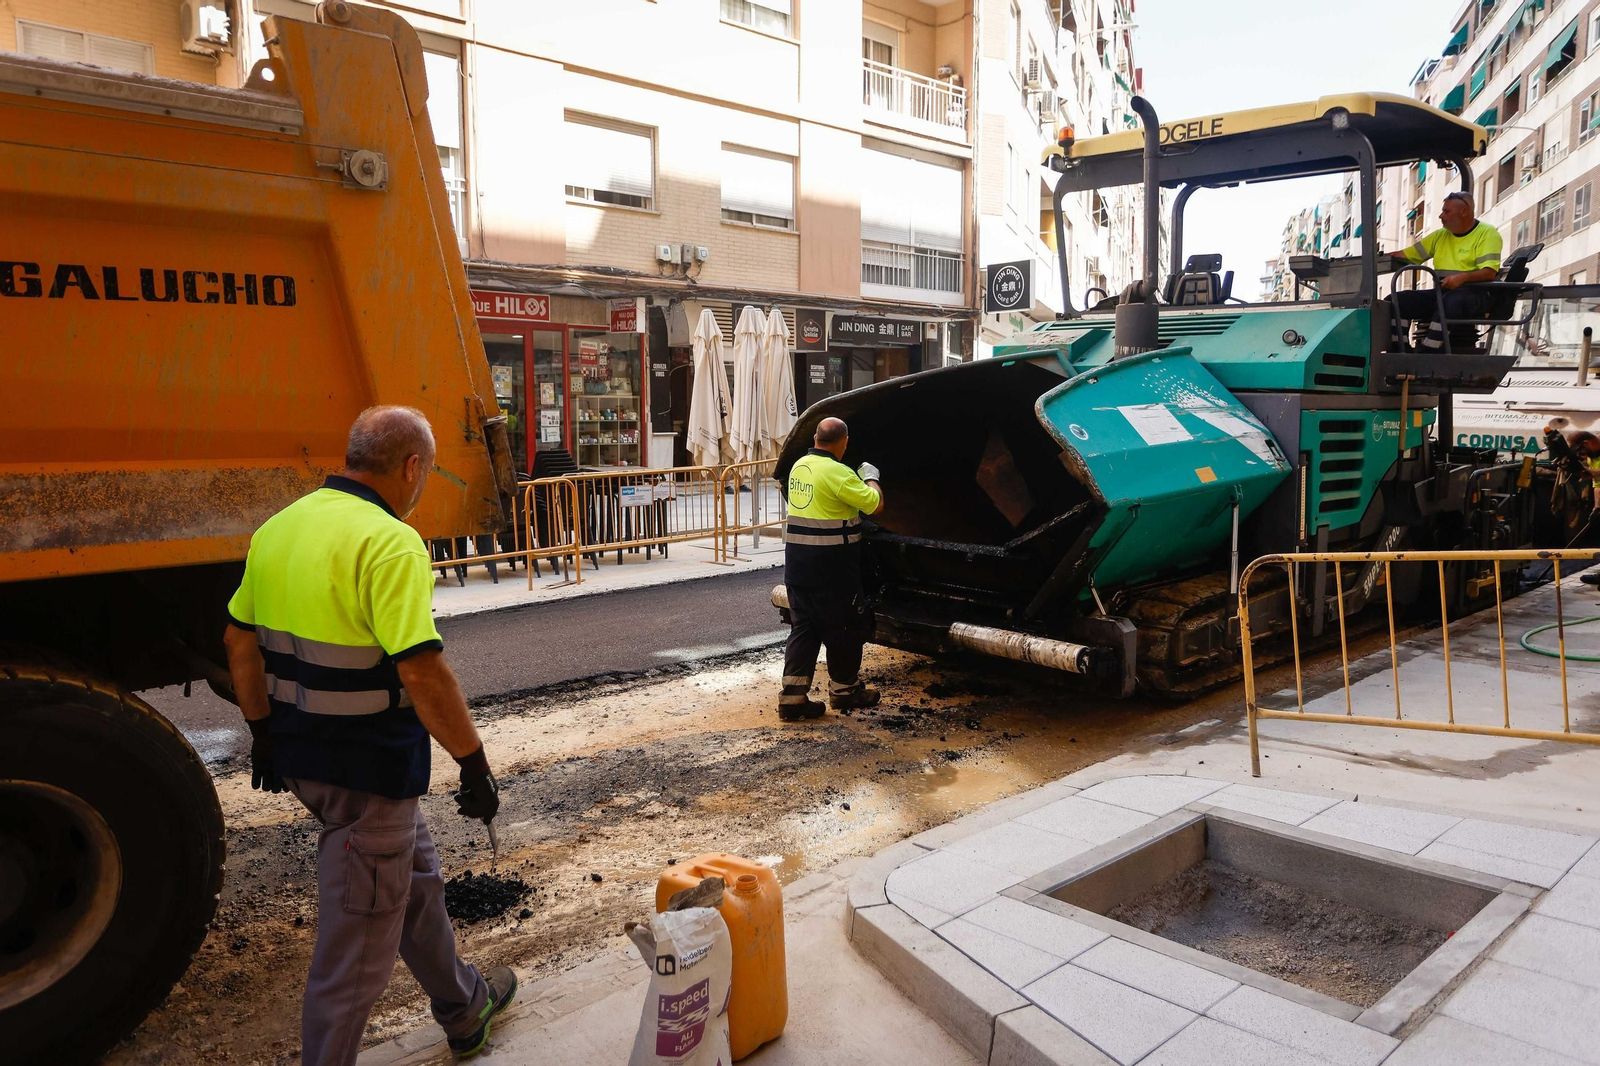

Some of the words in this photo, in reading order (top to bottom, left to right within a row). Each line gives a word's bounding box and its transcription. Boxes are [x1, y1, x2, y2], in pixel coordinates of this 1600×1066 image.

[1142, 118, 1223, 144] ÖGELE
[997, 271, 1006, 283] JIN
[1006, 269, 1020, 280] DING
[0, 261, 297, 307] GALUCHO
[1001, 281, 1016, 292] 金鼎
[1010, 291, 1019, 302] BAR
[472, 301, 490, 313] UE
[495, 296, 547, 316] HILOS
[839, 322, 852, 332] JIN
[854, 323, 875, 333] DING
[879, 323, 895, 335] 金鼎
[1383, 420, 1400, 429] BITUMAZ
[1457, 433, 1540, 453] CORINSA
[790, 477, 814, 493] Bitum
[660, 981, 709, 1014] i.speed
[681, 1030, 693, 1043] ALI
